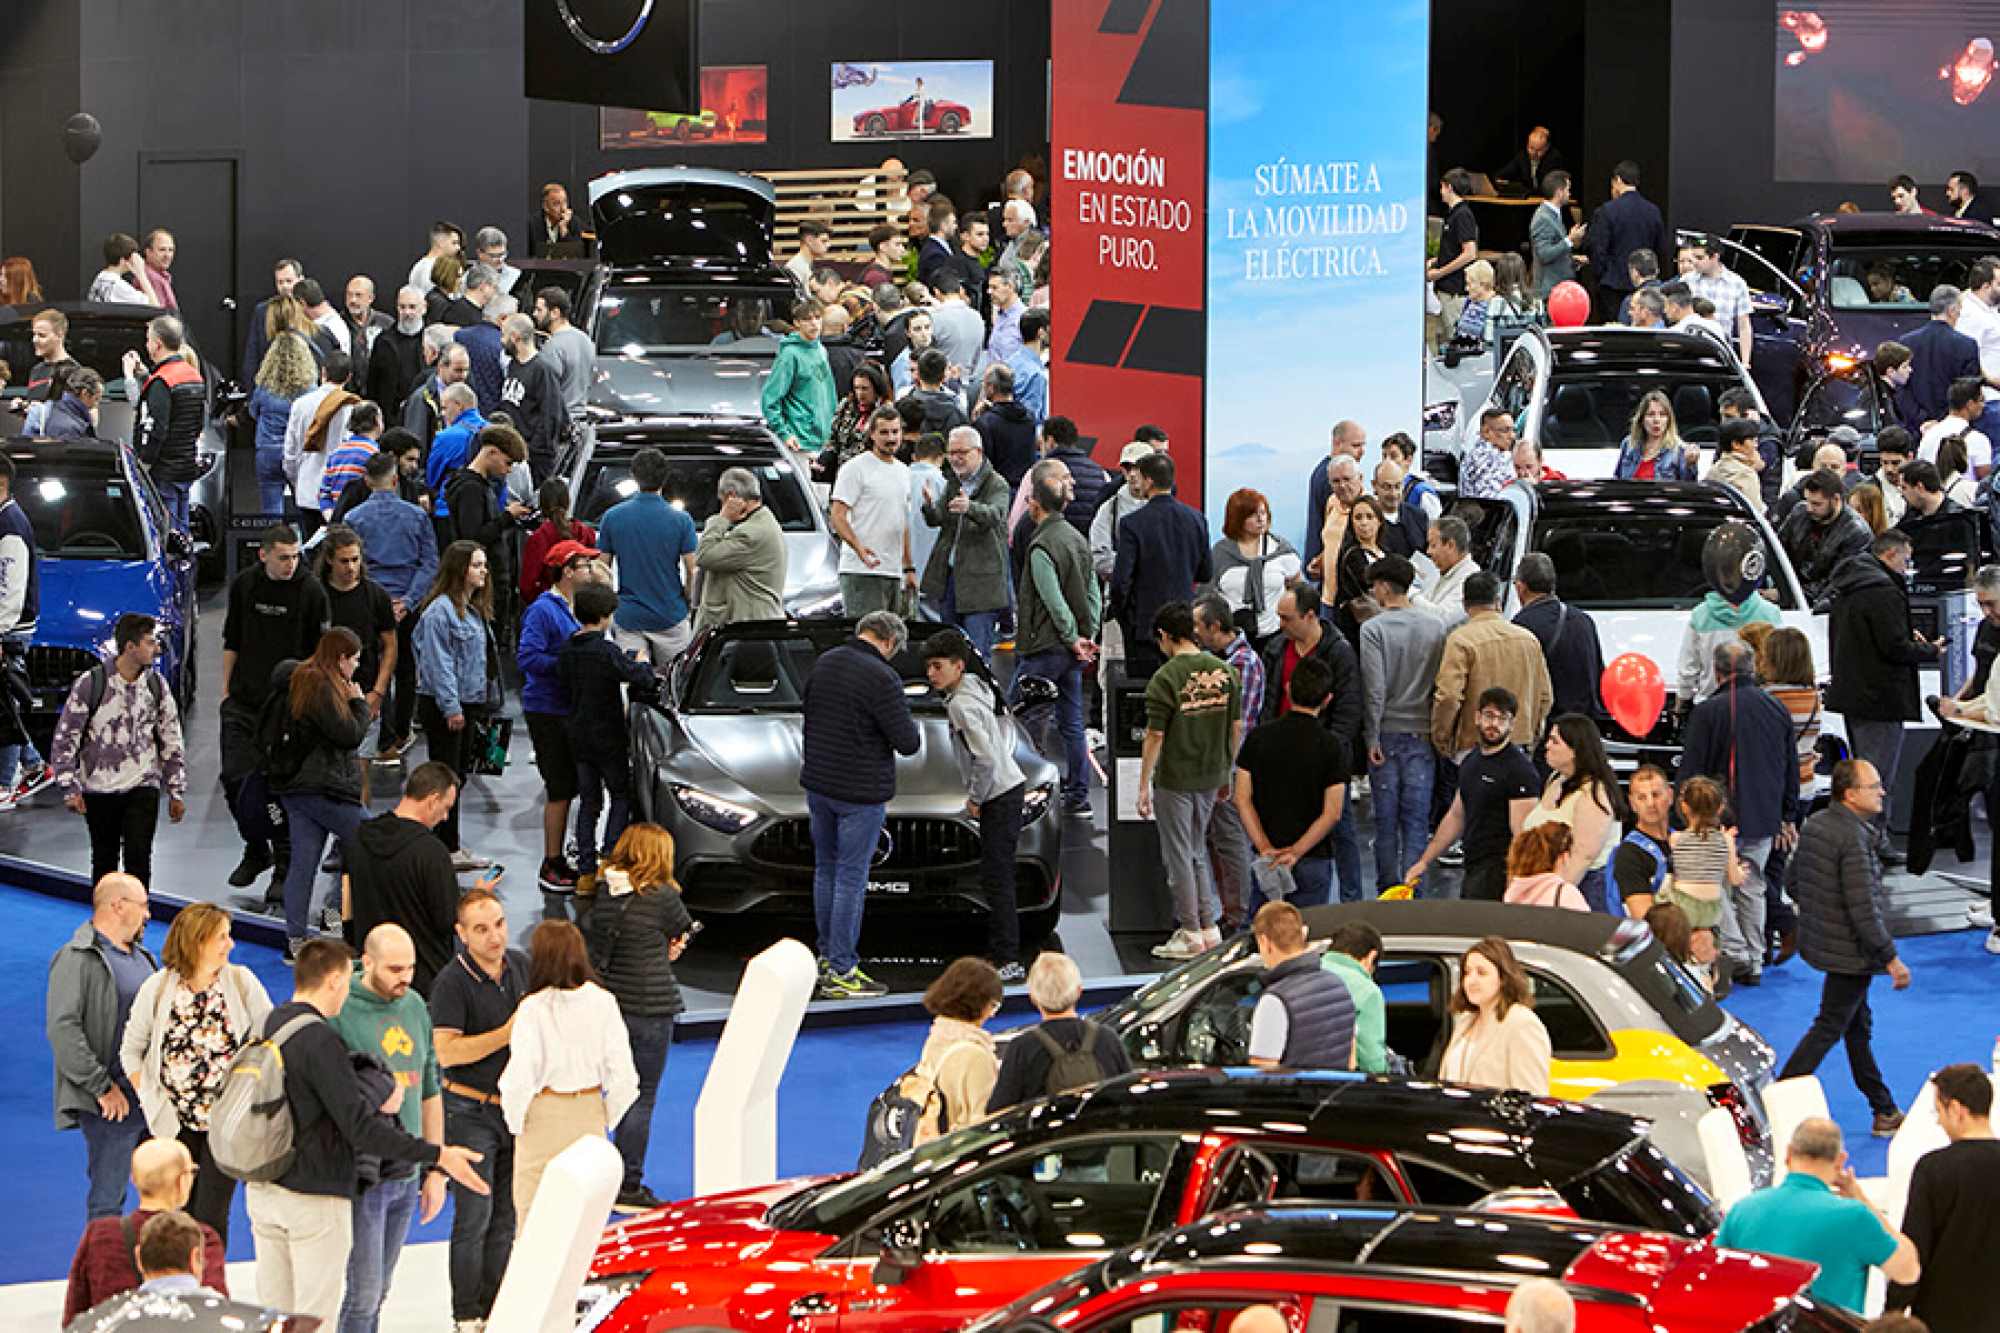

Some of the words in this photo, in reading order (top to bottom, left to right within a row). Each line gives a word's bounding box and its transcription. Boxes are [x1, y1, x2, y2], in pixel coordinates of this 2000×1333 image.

[1063, 148, 1166, 187] EMOCIÓN
[1254, 156, 1359, 197] SÚMATE
[1363, 161, 1382, 194] A
[1079, 190, 1105, 224] EN
[1111, 193, 1192, 232] ESTADO
[1226, 206, 1260, 239] LA
[1263, 202, 1409, 239] MOVILIDAD
[1099, 234, 1159, 271] PURO.
[1244, 240, 1388, 281] ELÉCTRICA.
